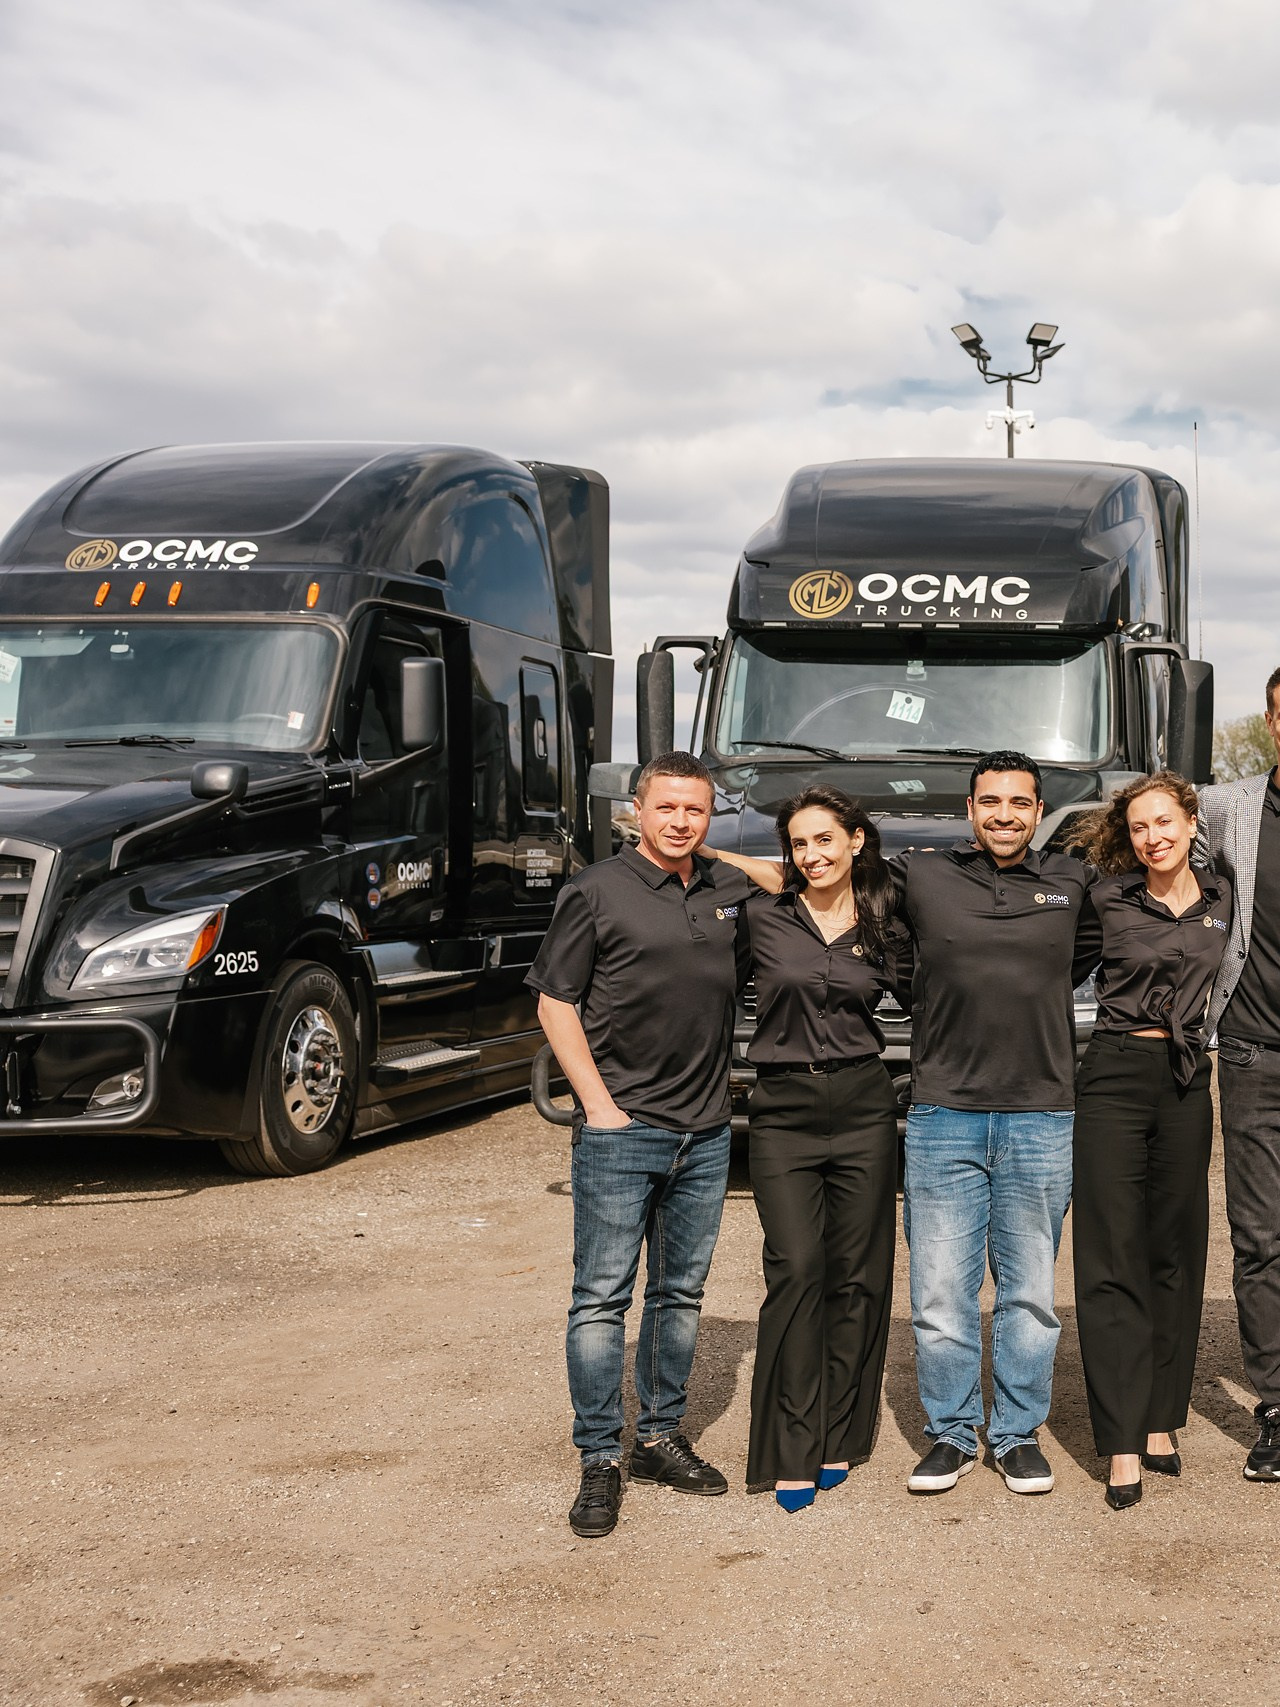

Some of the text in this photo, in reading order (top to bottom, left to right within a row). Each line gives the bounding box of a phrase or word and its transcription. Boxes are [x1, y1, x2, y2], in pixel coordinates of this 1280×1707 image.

[119, 539, 259, 564] OCMC
[111, 562, 250, 570] TRUCKING
[858, 573, 1031, 605] OCMC
[855, 605, 1028, 620] TRUCKING
[397, 862, 430, 881] OCMC
[214, 951, 259, 976] 2625
